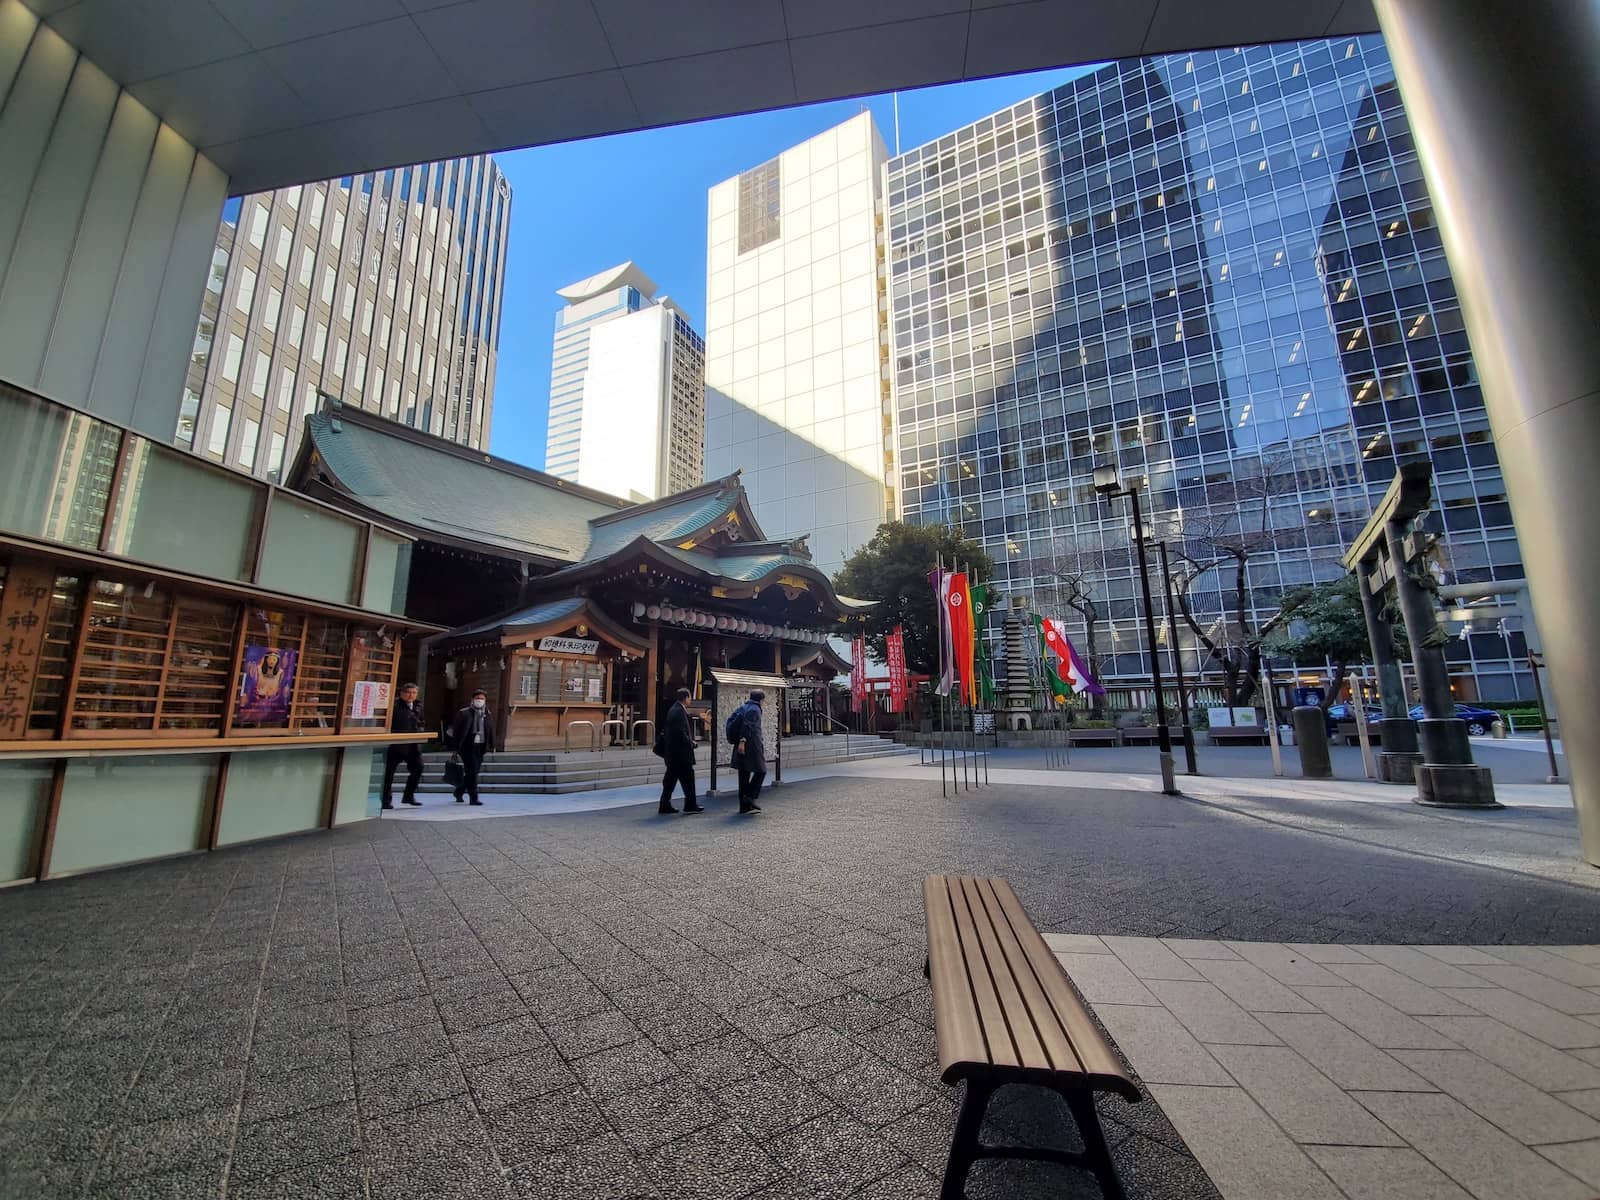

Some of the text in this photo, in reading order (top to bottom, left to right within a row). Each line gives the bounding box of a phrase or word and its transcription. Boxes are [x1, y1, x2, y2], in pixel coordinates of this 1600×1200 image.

[0, 577, 47, 733] 御神札授与所
